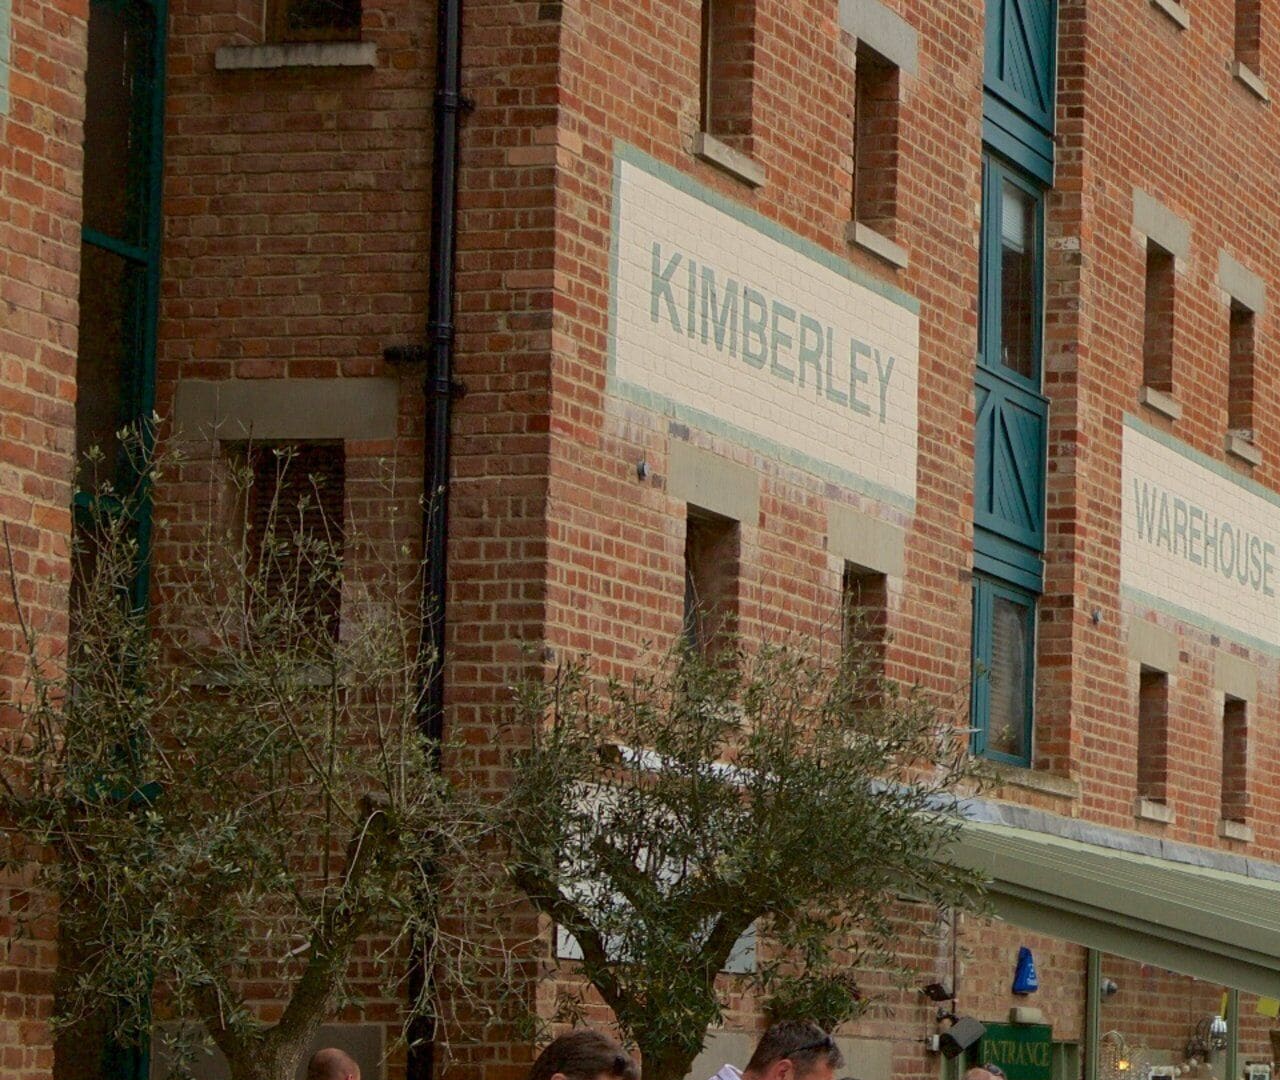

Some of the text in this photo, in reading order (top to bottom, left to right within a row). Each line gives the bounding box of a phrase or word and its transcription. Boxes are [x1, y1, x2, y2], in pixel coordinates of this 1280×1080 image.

[649, 240, 896, 425] KIMBERLEY
[1133, 477, 1277, 598] WAREHOUSE
[983, 1040, 1050, 1067] ENTRANCE
